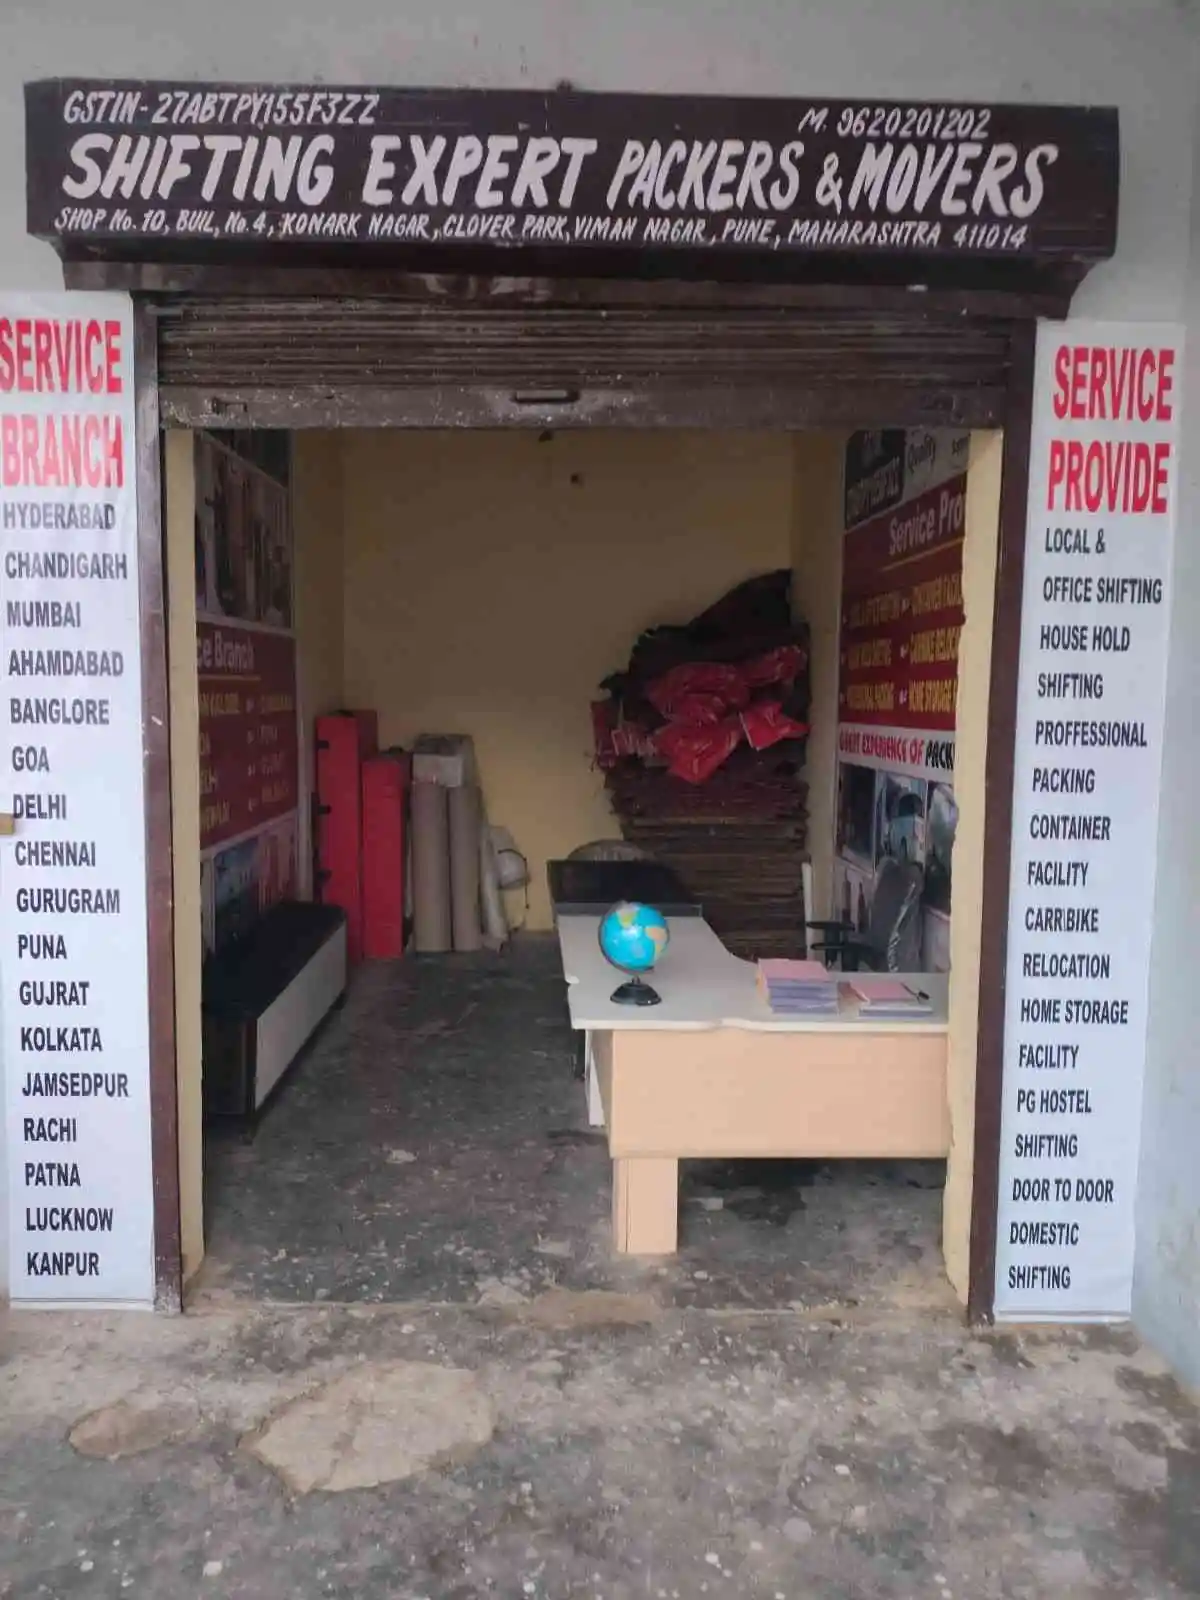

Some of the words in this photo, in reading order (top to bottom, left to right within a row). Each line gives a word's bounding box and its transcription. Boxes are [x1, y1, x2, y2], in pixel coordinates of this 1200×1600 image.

[798, 107, 828, 133] M.
[836, 107, 992, 140] 9620201202
[60, 132, 336, 205] SHIFTING
[361, 134, 598, 209] EXPERT
[606, 138, 805, 212] PACKERS
[814, 151, 844, 214] &
[848, 142, 1059, 220] MOVERS
[54, 206, 107, 234] SHOP
[108, 208, 137, 233] No.
[141, 208, 170, 236] 10,
[224, 211, 249, 234] No.
[252, 210, 275, 238] 4,
[280, 212, 361, 238] KONARK
[367, 212, 441, 242] NAGAR,
[443, 214, 514, 239] CLOVER
[573, 215, 638, 241] VIMAN
[721, 217, 781, 250] PUNE,
[786, 219, 941, 249] MAHARASHTRA
[952, 223, 1030, 249] 411014
[0, 316, 123, 394] SERVICE
[1052, 344, 1175, 421] SERVICE
[2, 413, 124, 488] BRANCH
[1047, 440, 1170, 514] PROVIDE
[3, 500, 117, 531] HYDERABAD
[888, 503, 935, 556] Service
[1045, 528, 1091, 555] LOCAL
[1094, 528, 1106, 555] &
[4, 549, 129, 582] CHANDIGARH
[1043, 577, 1093, 603] OFFICE
[1096, 577, 1163, 605] SHIFTING
[6, 599, 82, 630] MUMBAI
[1040, 625, 1088, 652] HOUSE
[1091, 625, 1131, 652] HOLD
[8, 648, 125, 679] AHAMDABAD
[1037, 673, 1104, 700] SHIFTING
[9, 695, 111, 727] BANGLORE
[1035, 721, 1148, 748] PROFFESSIONAL
[11, 744, 51, 774] GOA
[1032, 768, 1096, 794] PACKING
[12, 793, 68, 821] DELHI
[1029, 814, 1111, 841] CONTAINER
[14, 840, 97, 868] CHENNAI
[1027, 860, 1089, 886] FACILITY
[15, 887, 121, 916] GURUGRAM
[17, 933, 68, 960] PUNA
[1022, 952, 1110, 979] RELOCATION
[18, 980, 91, 1007] GUJRAT
[1020, 998, 1061, 1024] HOME
[1064, 999, 1129, 1025] STORAGE
[20, 1026, 104, 1053] KOLKATA
[1018, 1043, 1079, 1069] FACILITY
[21, 1071, 130, 1099] JAMSEDPUR
[1016, 1087, 1037, 1113] PG
[1039, 1087, 1092, 1114] HOSTEL
[23, 1117, 78, 1144] RACHI
[1014, 1133, 1078, 1158] SHIFTING
[24, 1161, 82, 1188] PATNA
[1011, 1177, 1050, 1203] DOOR
[1053, 1177, 1072, 1203] TO
[1075, 1178, 1114, 1204] DOOR
[25, 1207, 115, 1233] LUCKNOW
[1009, 1221, 1080, 1247] DOMESTIC
[26, 1251, 100, 1277] KANPUR
[1007, 1265, 1071, 1291] SHIFTING
